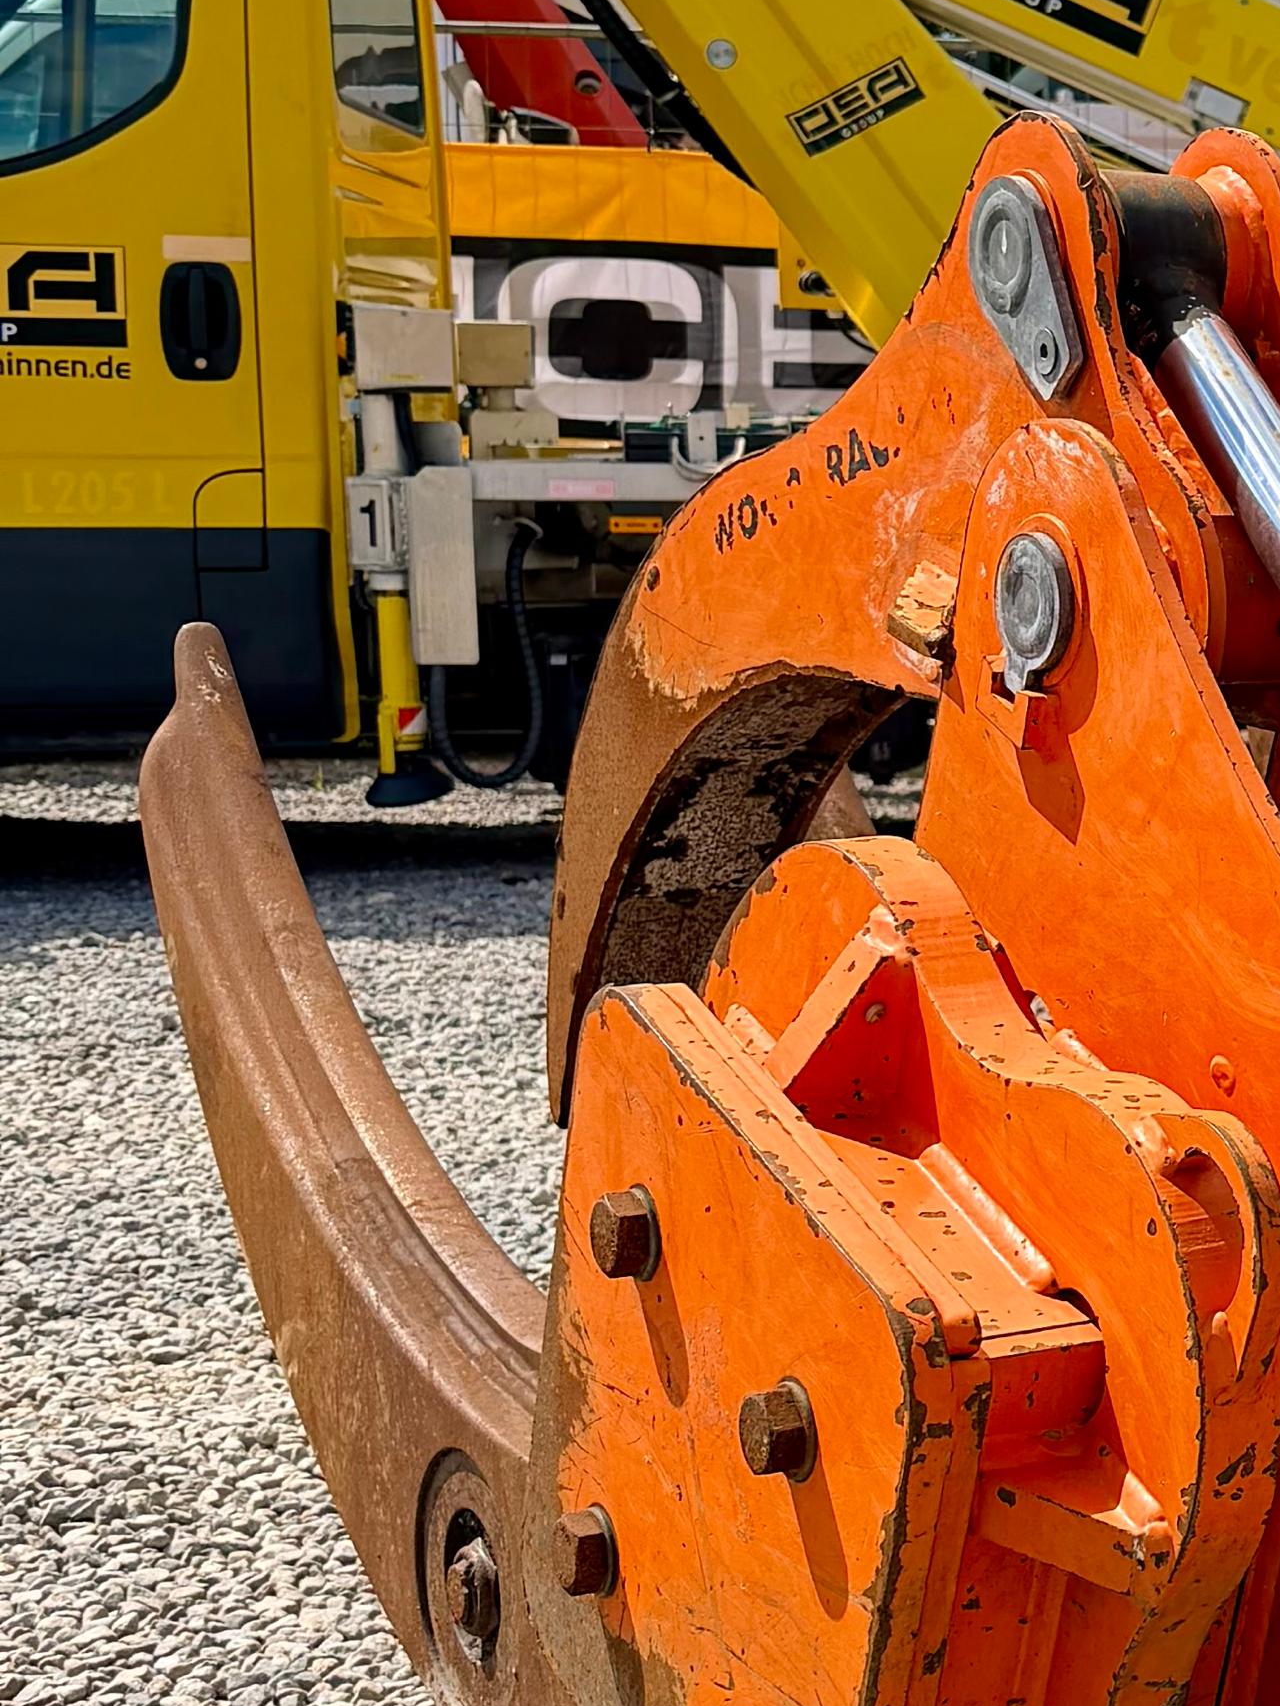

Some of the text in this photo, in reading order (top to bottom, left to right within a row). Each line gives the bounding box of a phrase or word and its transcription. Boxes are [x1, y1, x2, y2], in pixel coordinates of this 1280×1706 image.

[840, 108, 886, 139] GROUP
[0, 351, 131, 380] innen.de
[359, 499, 378, 548] 1
